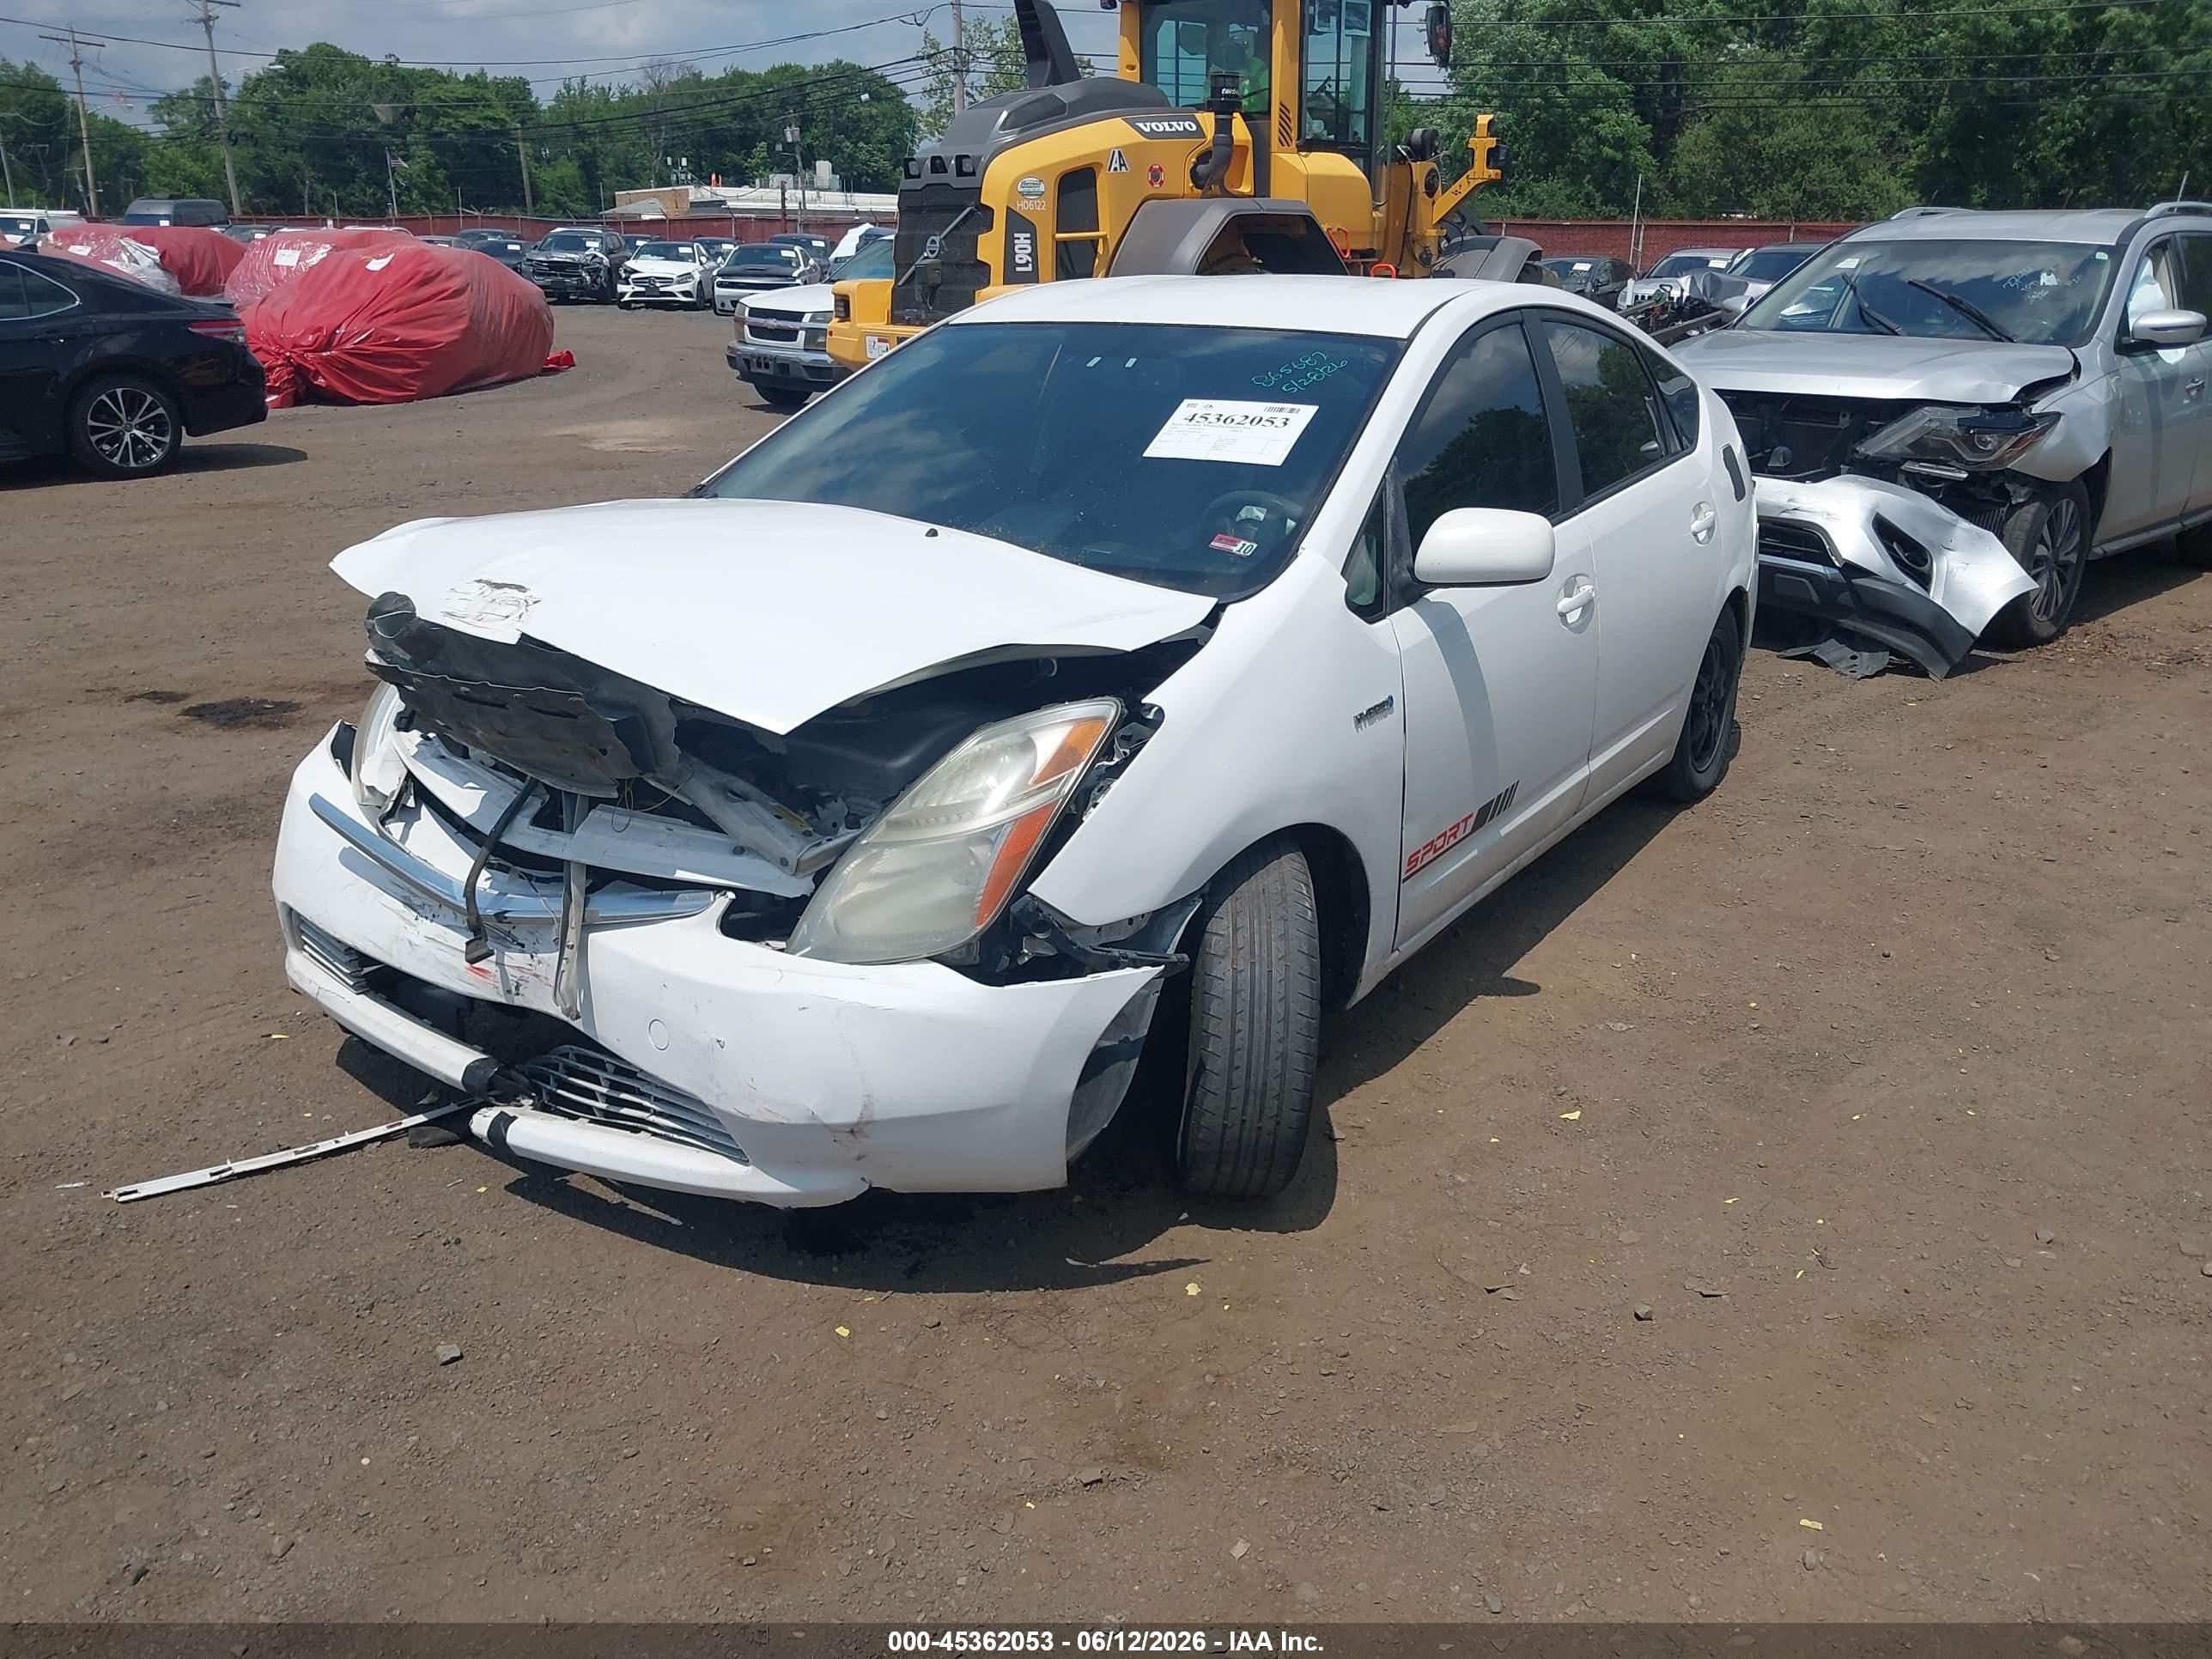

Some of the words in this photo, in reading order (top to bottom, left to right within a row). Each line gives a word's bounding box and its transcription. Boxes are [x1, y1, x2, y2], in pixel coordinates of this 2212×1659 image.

[1135, 121, 1197, 132] VOLVO
[1013, 233, 1032, 272] L90H
[1183, 412, 1291, 428] 45362053
[1237, 543, 1255, 555] 10
[1405, 812, 1474, 875] SPORT
